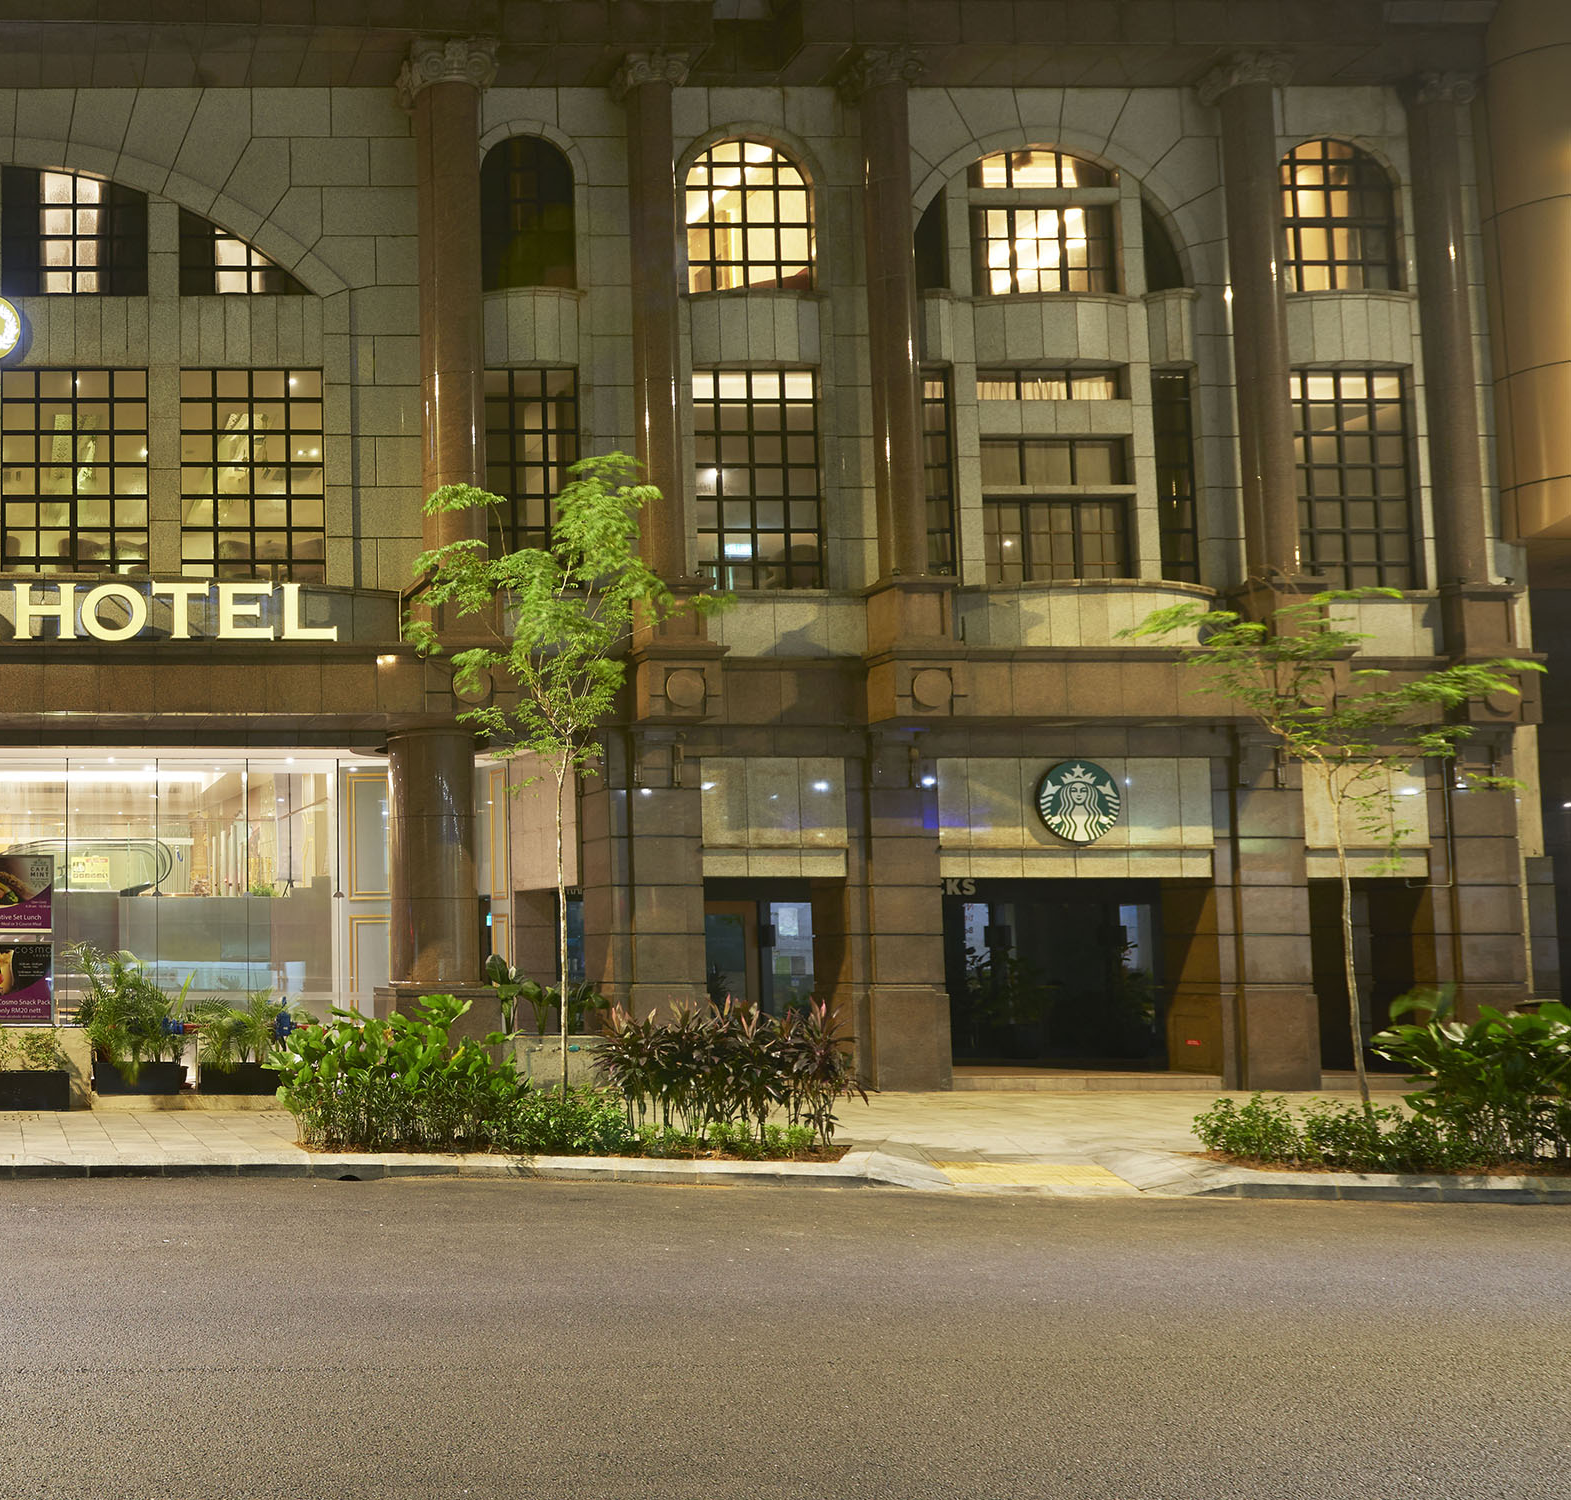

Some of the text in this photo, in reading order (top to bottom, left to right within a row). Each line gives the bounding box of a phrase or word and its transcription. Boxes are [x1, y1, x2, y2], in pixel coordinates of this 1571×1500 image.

[13, 581, 338, 641] HOTEL
[13, 913, 23, 921] Set
[24, 913, 42, 921] Lunch
[19, 998, 36, 1006] Snack
